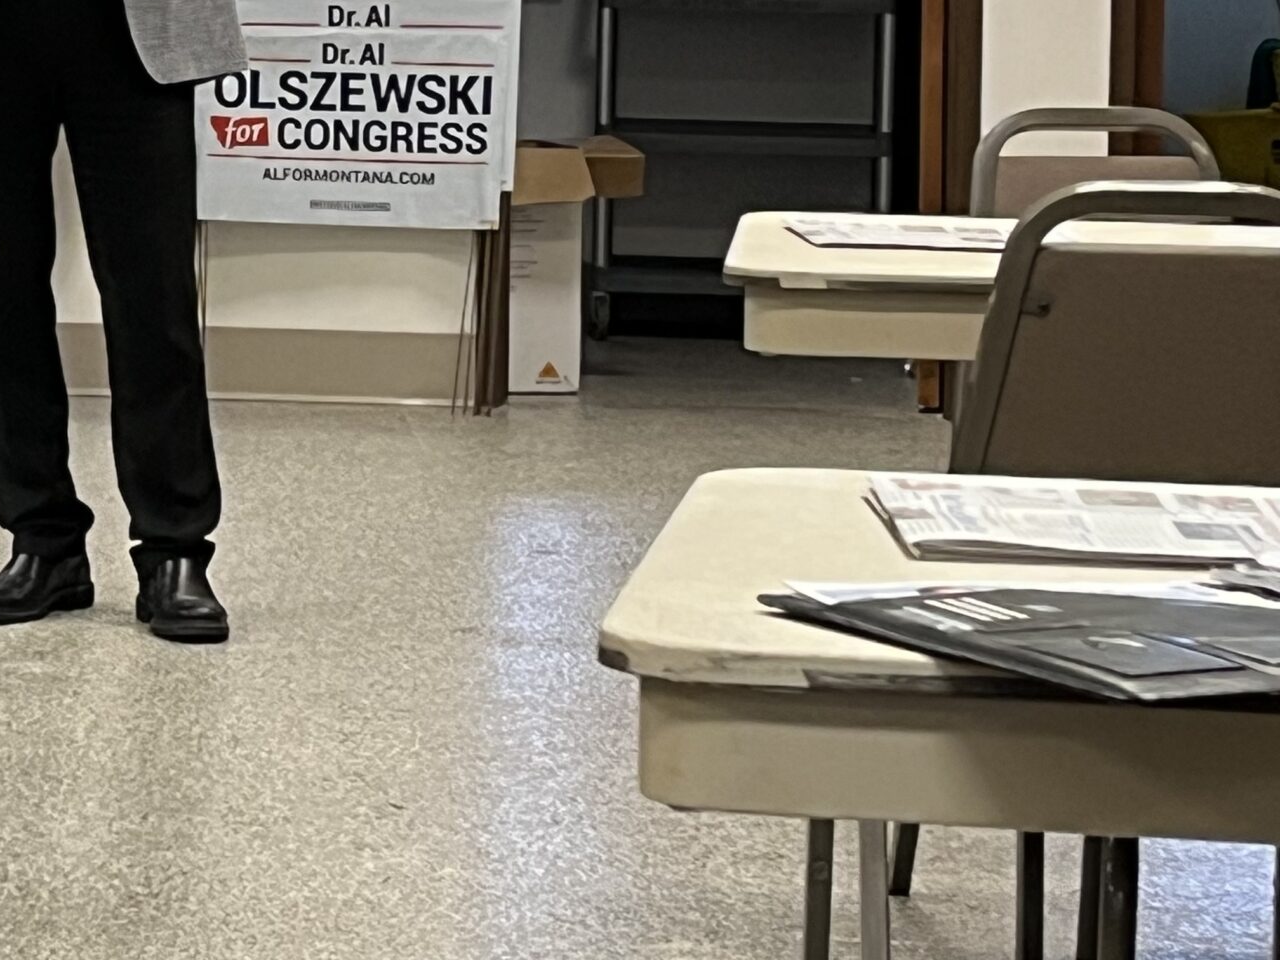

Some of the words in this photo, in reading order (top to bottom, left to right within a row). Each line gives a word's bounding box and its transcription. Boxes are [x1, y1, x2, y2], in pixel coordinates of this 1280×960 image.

[328, 5, 361, 27] Dr.
[365, 4, 390, 28] Al
[322, 43, 355, 65] Dr.
[359, 42, 385, 66] Al
[214, 69, 492, 115] OLSZEWSKI
[224, 118, 265, 149] for
[277, 117, 488, 155] CONGRESS
[263, 167, 436, 186] ALFORMONTANA.COM
